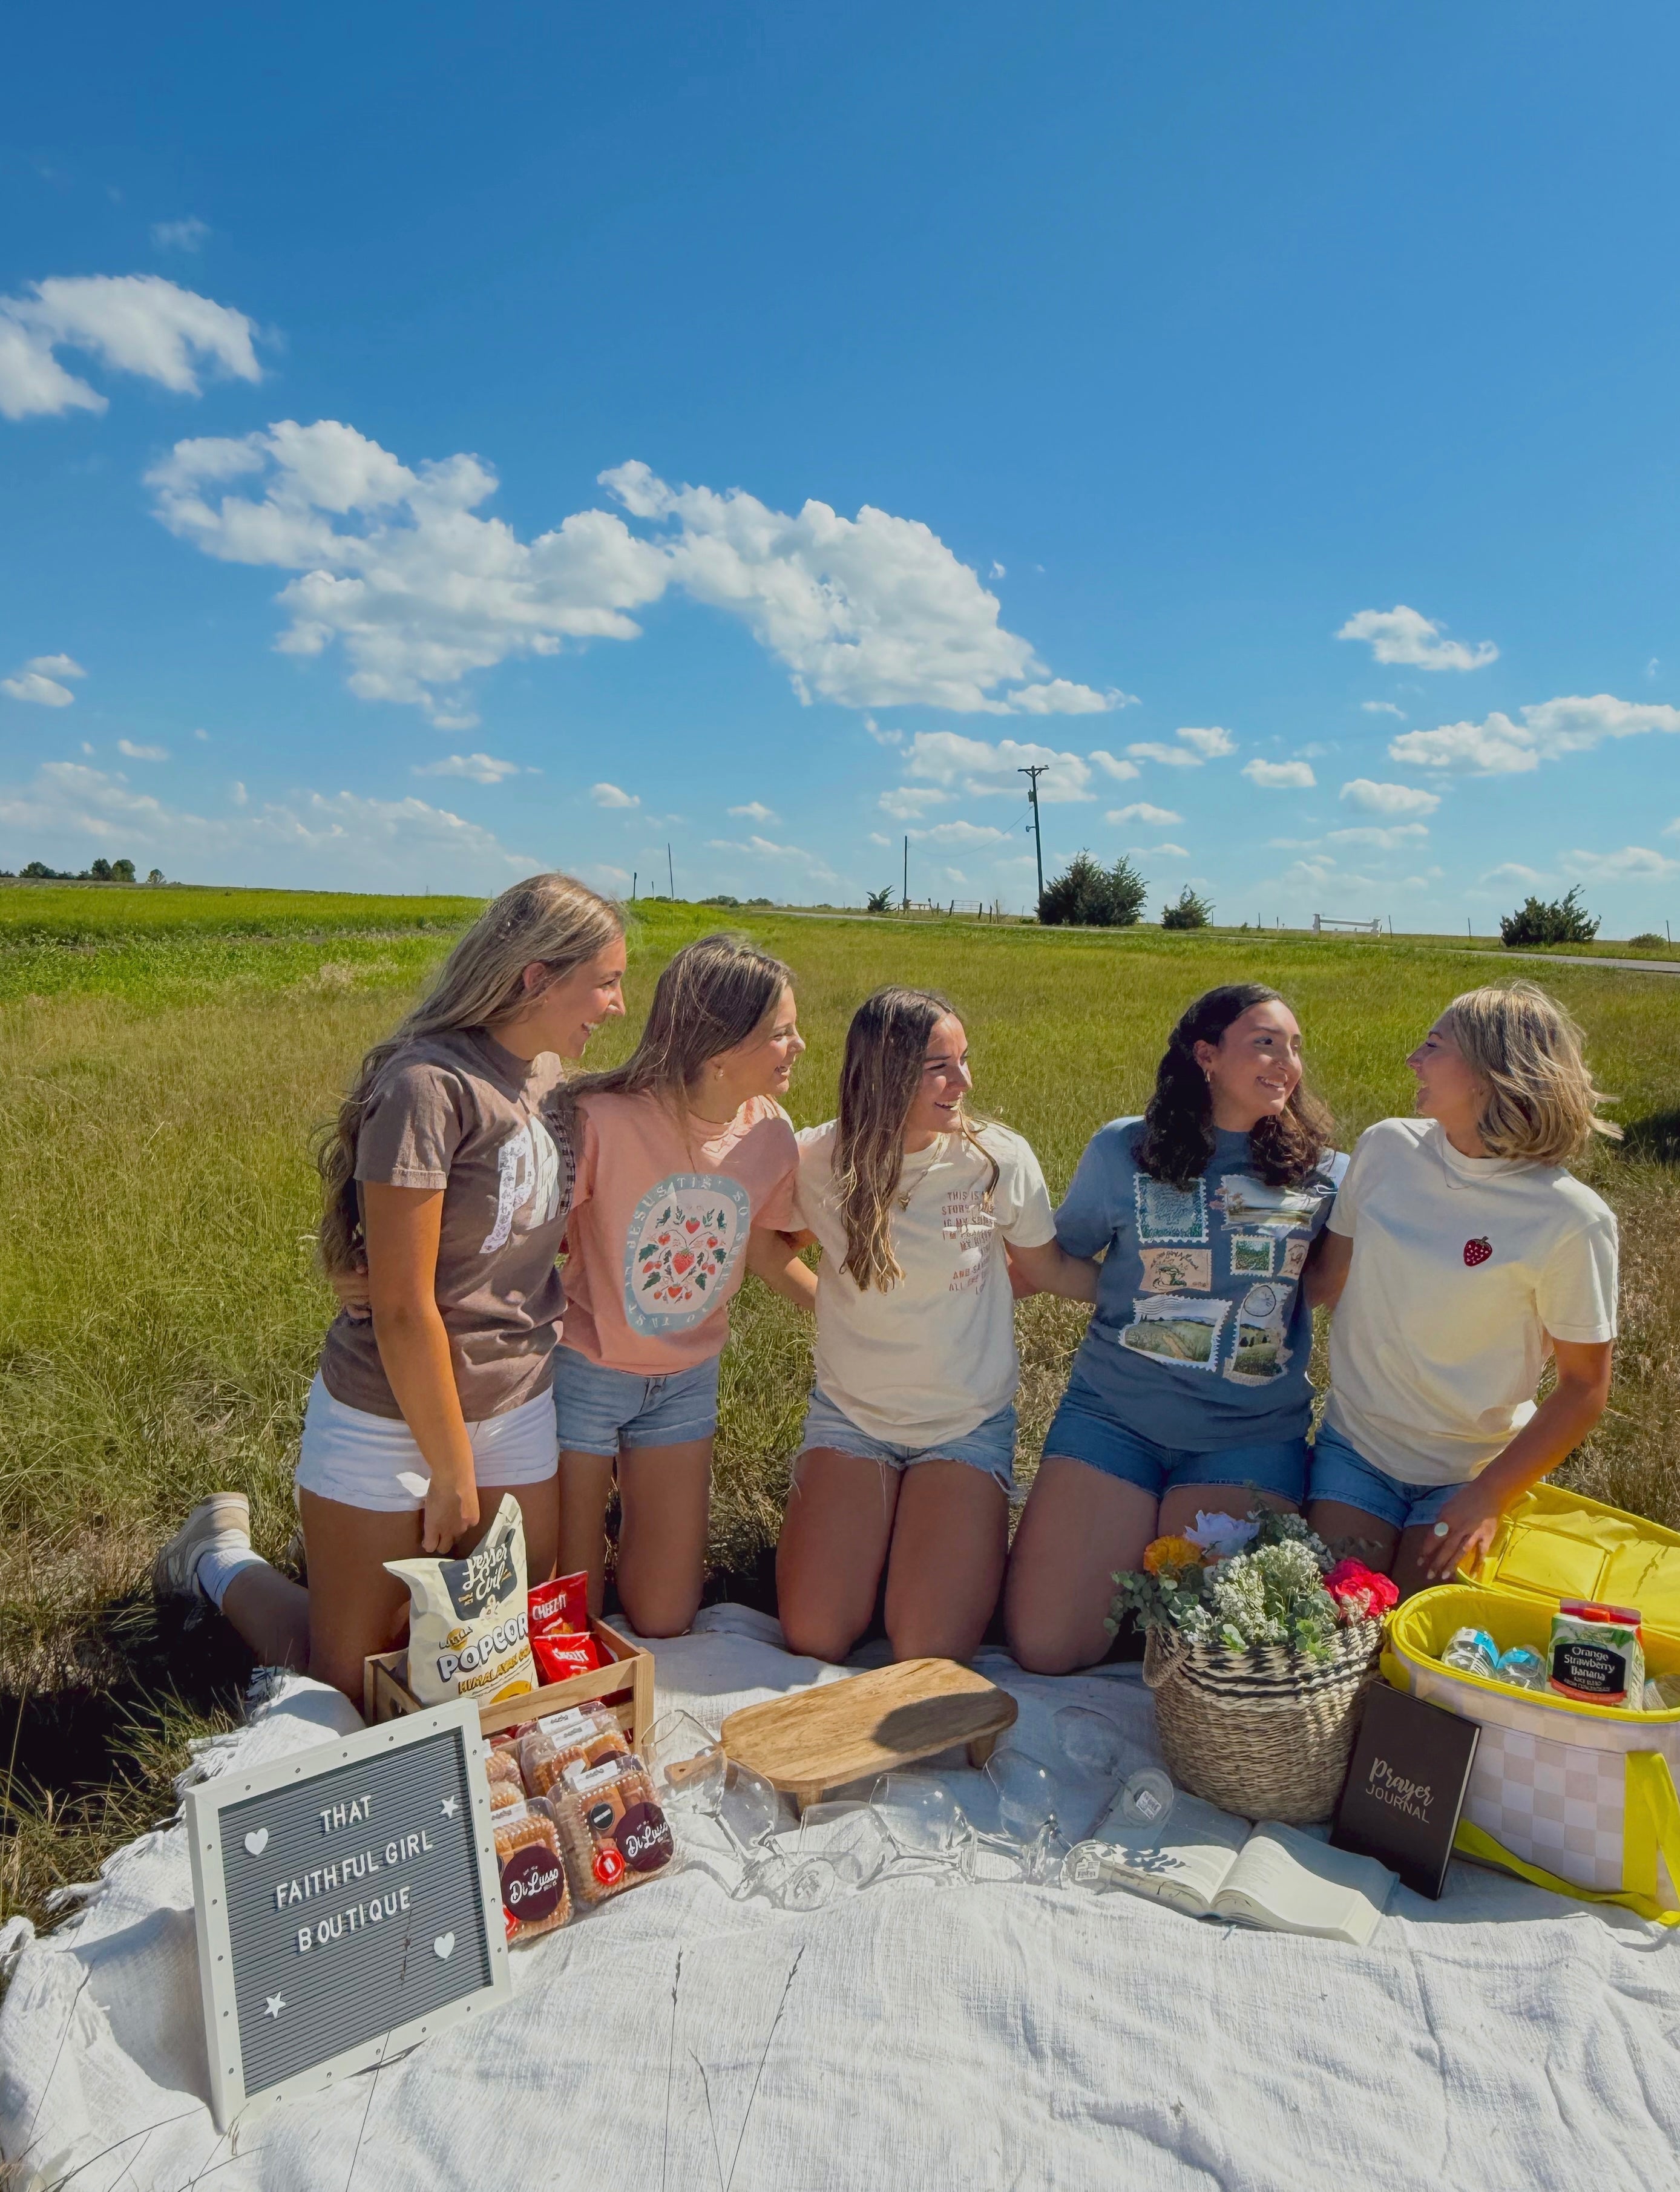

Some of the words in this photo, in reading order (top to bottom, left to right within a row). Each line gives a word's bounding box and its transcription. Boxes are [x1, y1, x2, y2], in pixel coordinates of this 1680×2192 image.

[947, 1190, 968, 1202] THIS
[462, 1543, 507, 1591] Lesser
[475, 1560, 506, 1601] Evil
[1563, 1653, 1616, 1674] Strawberry
[1570, 1665, 1606, 1681] Banana
[1572, 1646, 1609, 1661] Orange
[1369, 1757, 1435, 1806] Prayer
[320, 1795, 372, 1832] THAT
[1365, 1783, 1430, 1824] JOURNAL
[276, 1850, 379, 1908] FAITHFUL
[385, 1829, 433, 1864] GIRL
[527, 1868, 559, 1897] Lusso
[298, 1885, 411, 1952] BOUTIQUE
